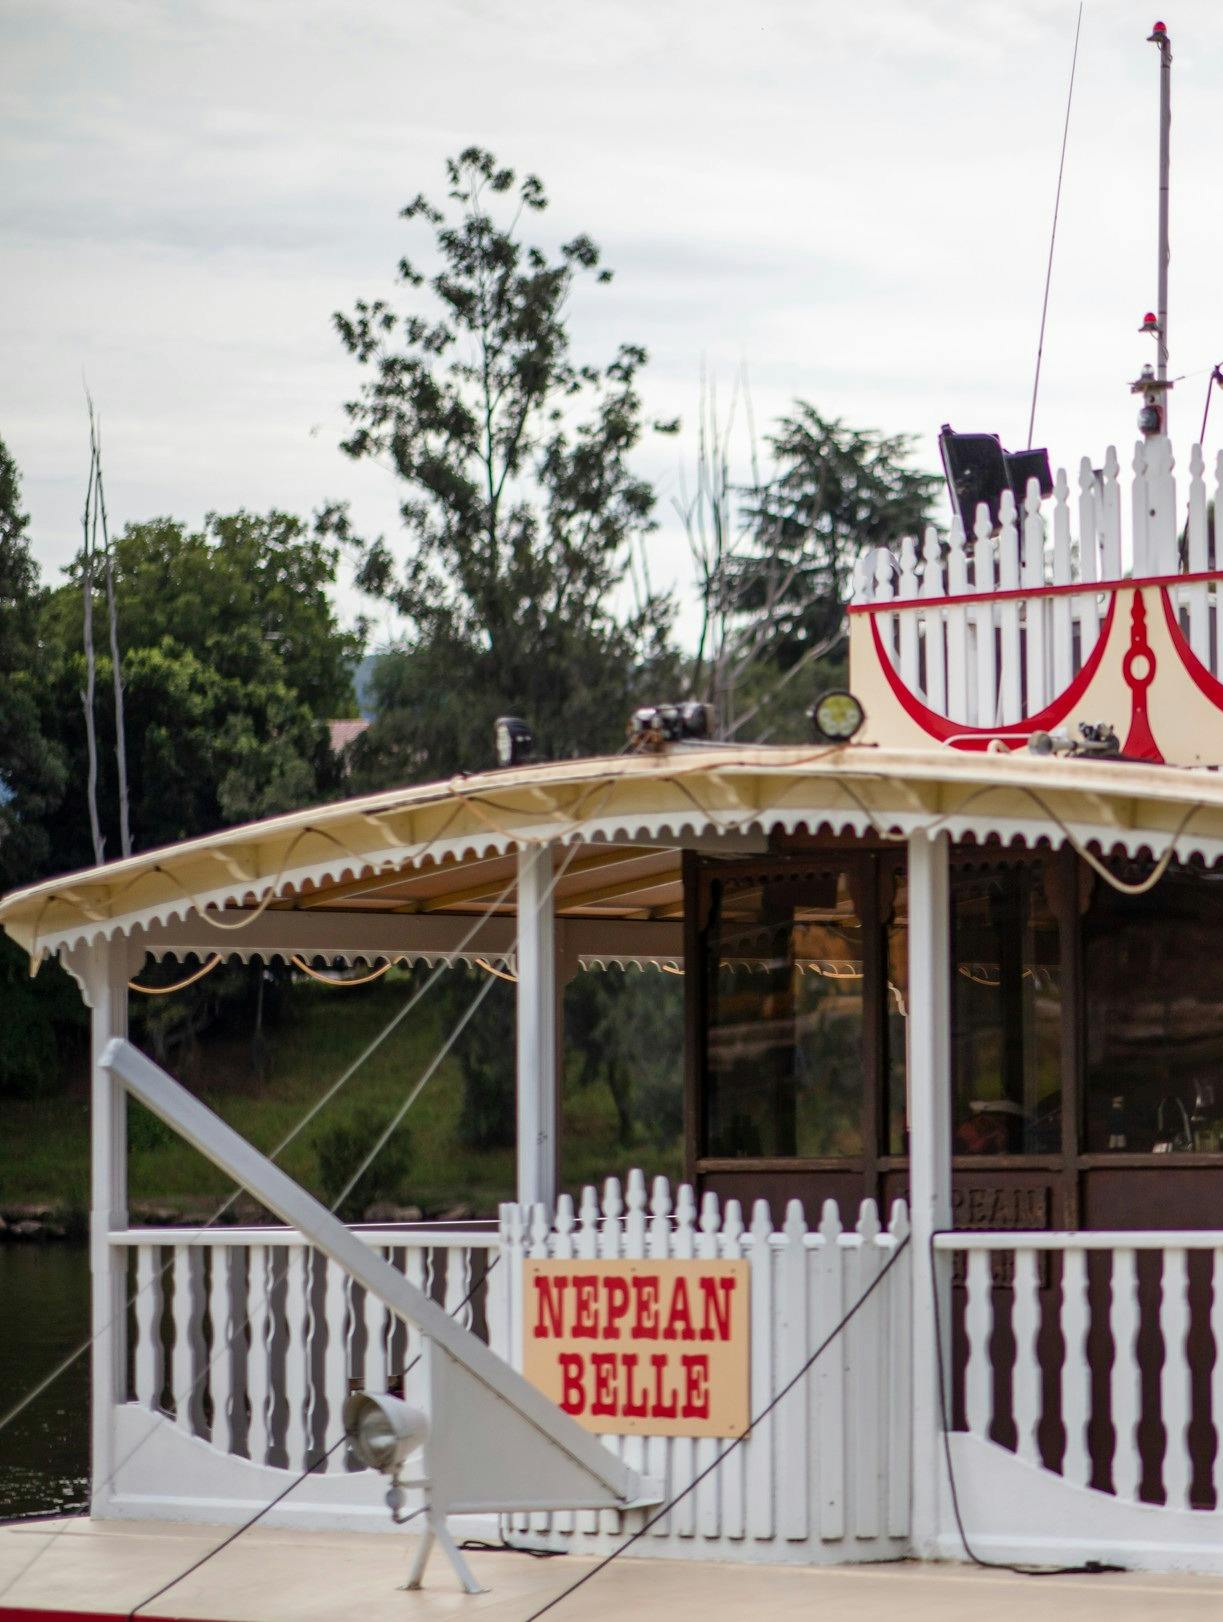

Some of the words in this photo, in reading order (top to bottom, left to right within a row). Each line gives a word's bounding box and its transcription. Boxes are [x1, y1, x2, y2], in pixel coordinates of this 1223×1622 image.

[951, 1188, 1043, 1225] PEAN
[533, 1275, 736, 1341] NEPEAN
[558, 1352, 710, 1420] BELLE
